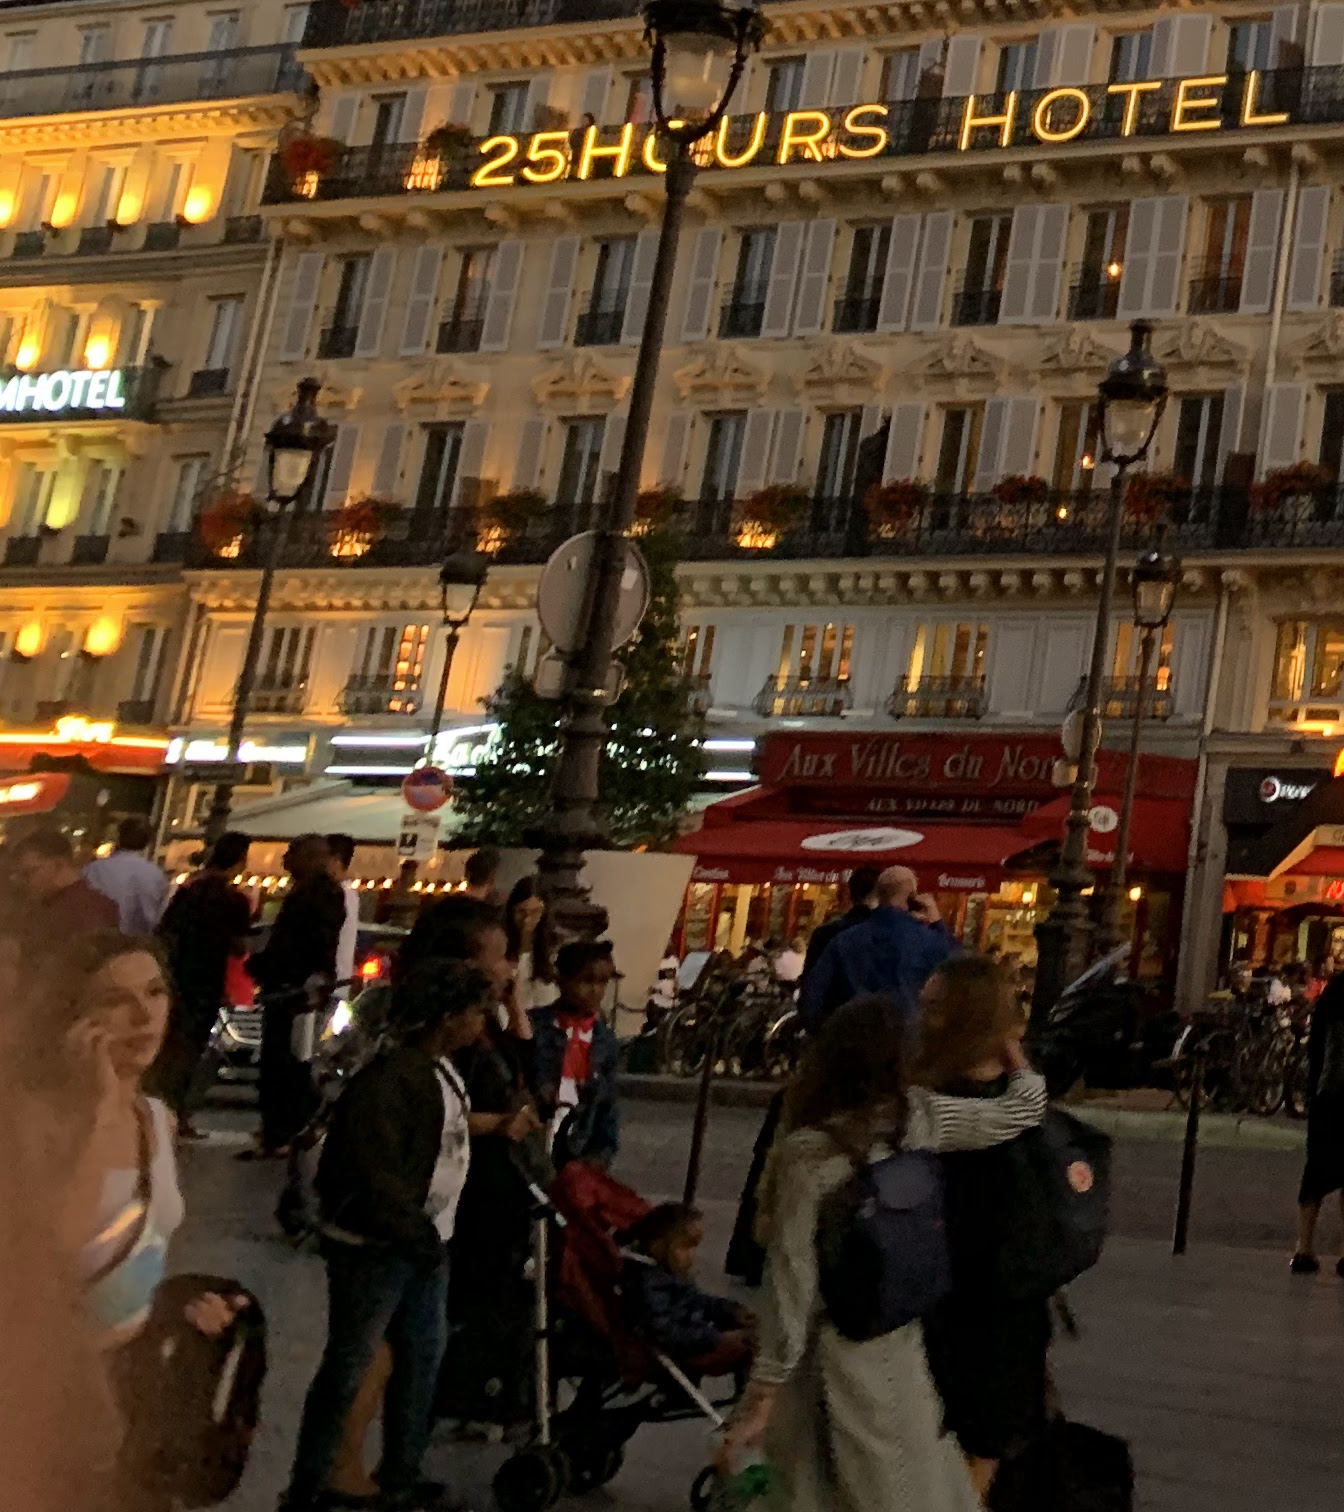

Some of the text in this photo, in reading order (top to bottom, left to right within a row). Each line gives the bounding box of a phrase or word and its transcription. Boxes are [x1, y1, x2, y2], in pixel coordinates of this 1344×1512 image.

[958, 70, 1290, 151] HOTEL
[777, 745, 840, 780] Aux
[944, 746, 983, 778] du
[988, 743, 1058, 785] Nor
